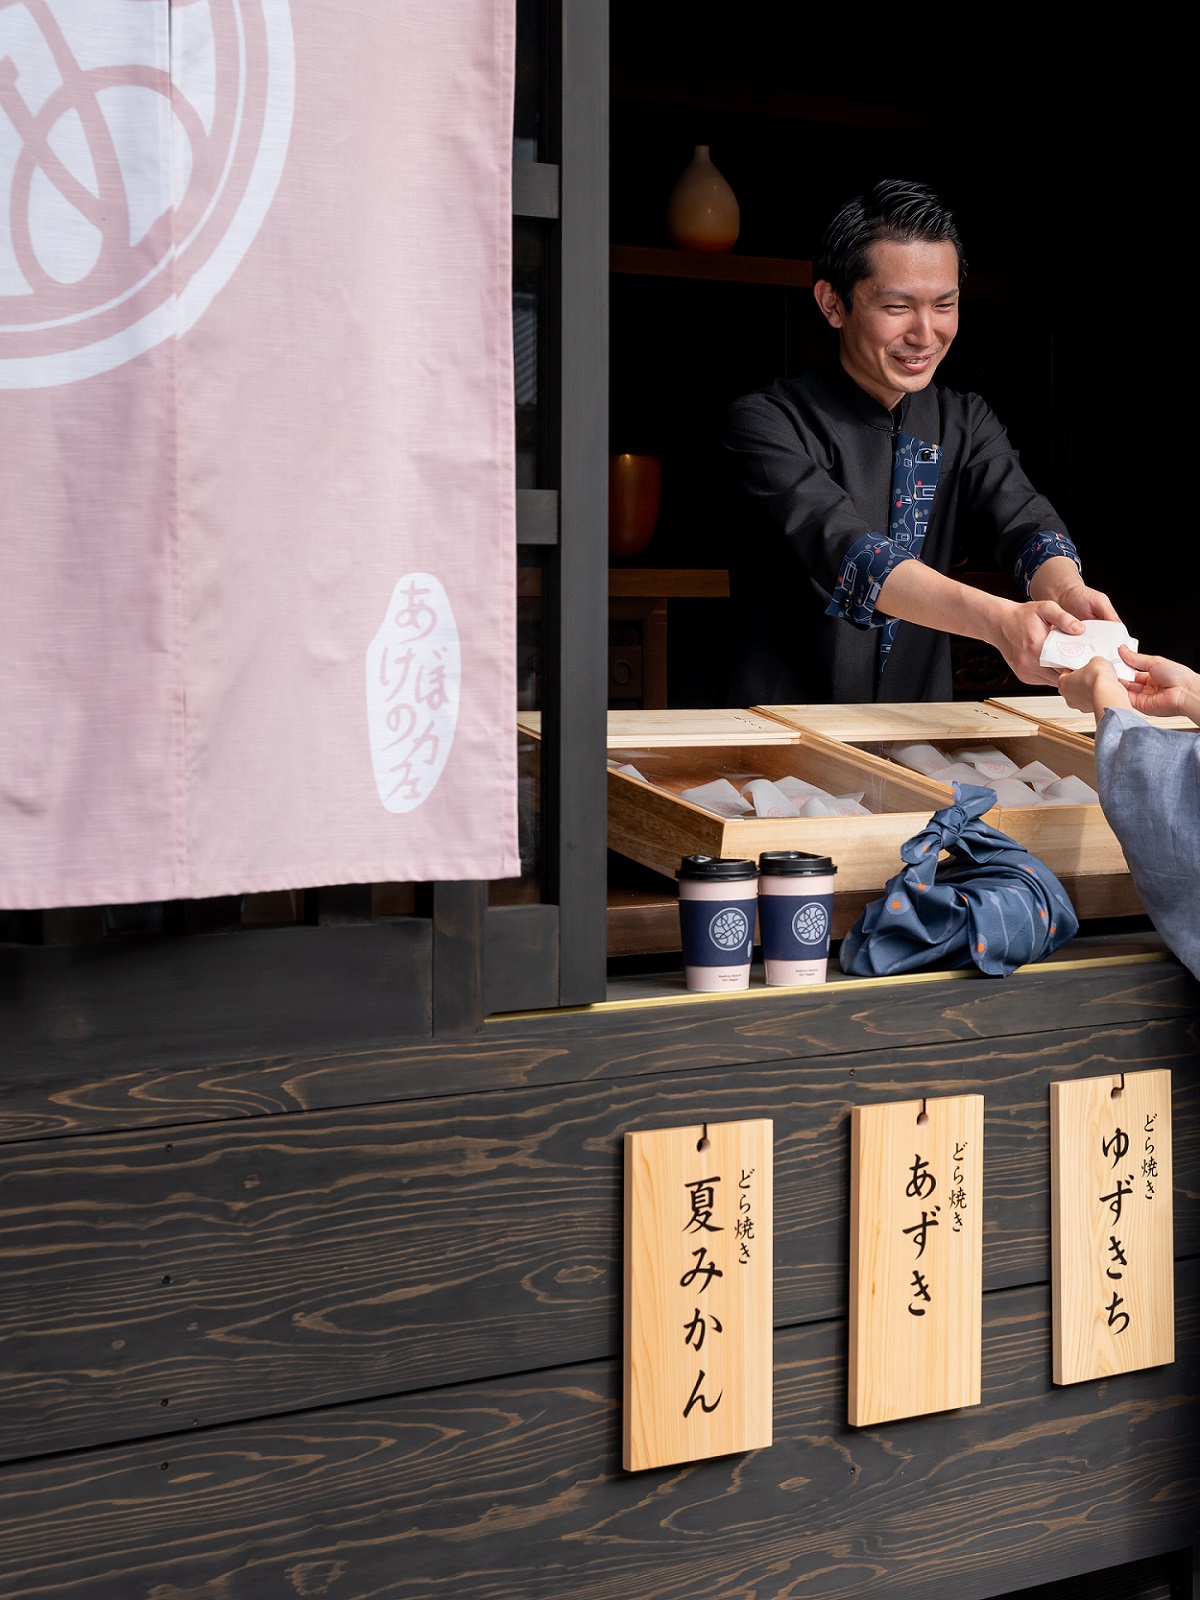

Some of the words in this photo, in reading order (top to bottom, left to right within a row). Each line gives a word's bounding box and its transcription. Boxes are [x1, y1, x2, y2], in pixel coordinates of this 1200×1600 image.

[734, 1168, 755, 1265] どら焼き
[951, 1142, 968, 1233] どら焼き
[1141, 1113, 1158, 1200] どら焼き
[902, 1153, 940, 1317] あずき
[1099, 1127, 1134, 1335] ゆずきち
[679, 1176, 724, 1419] 夏みかん
